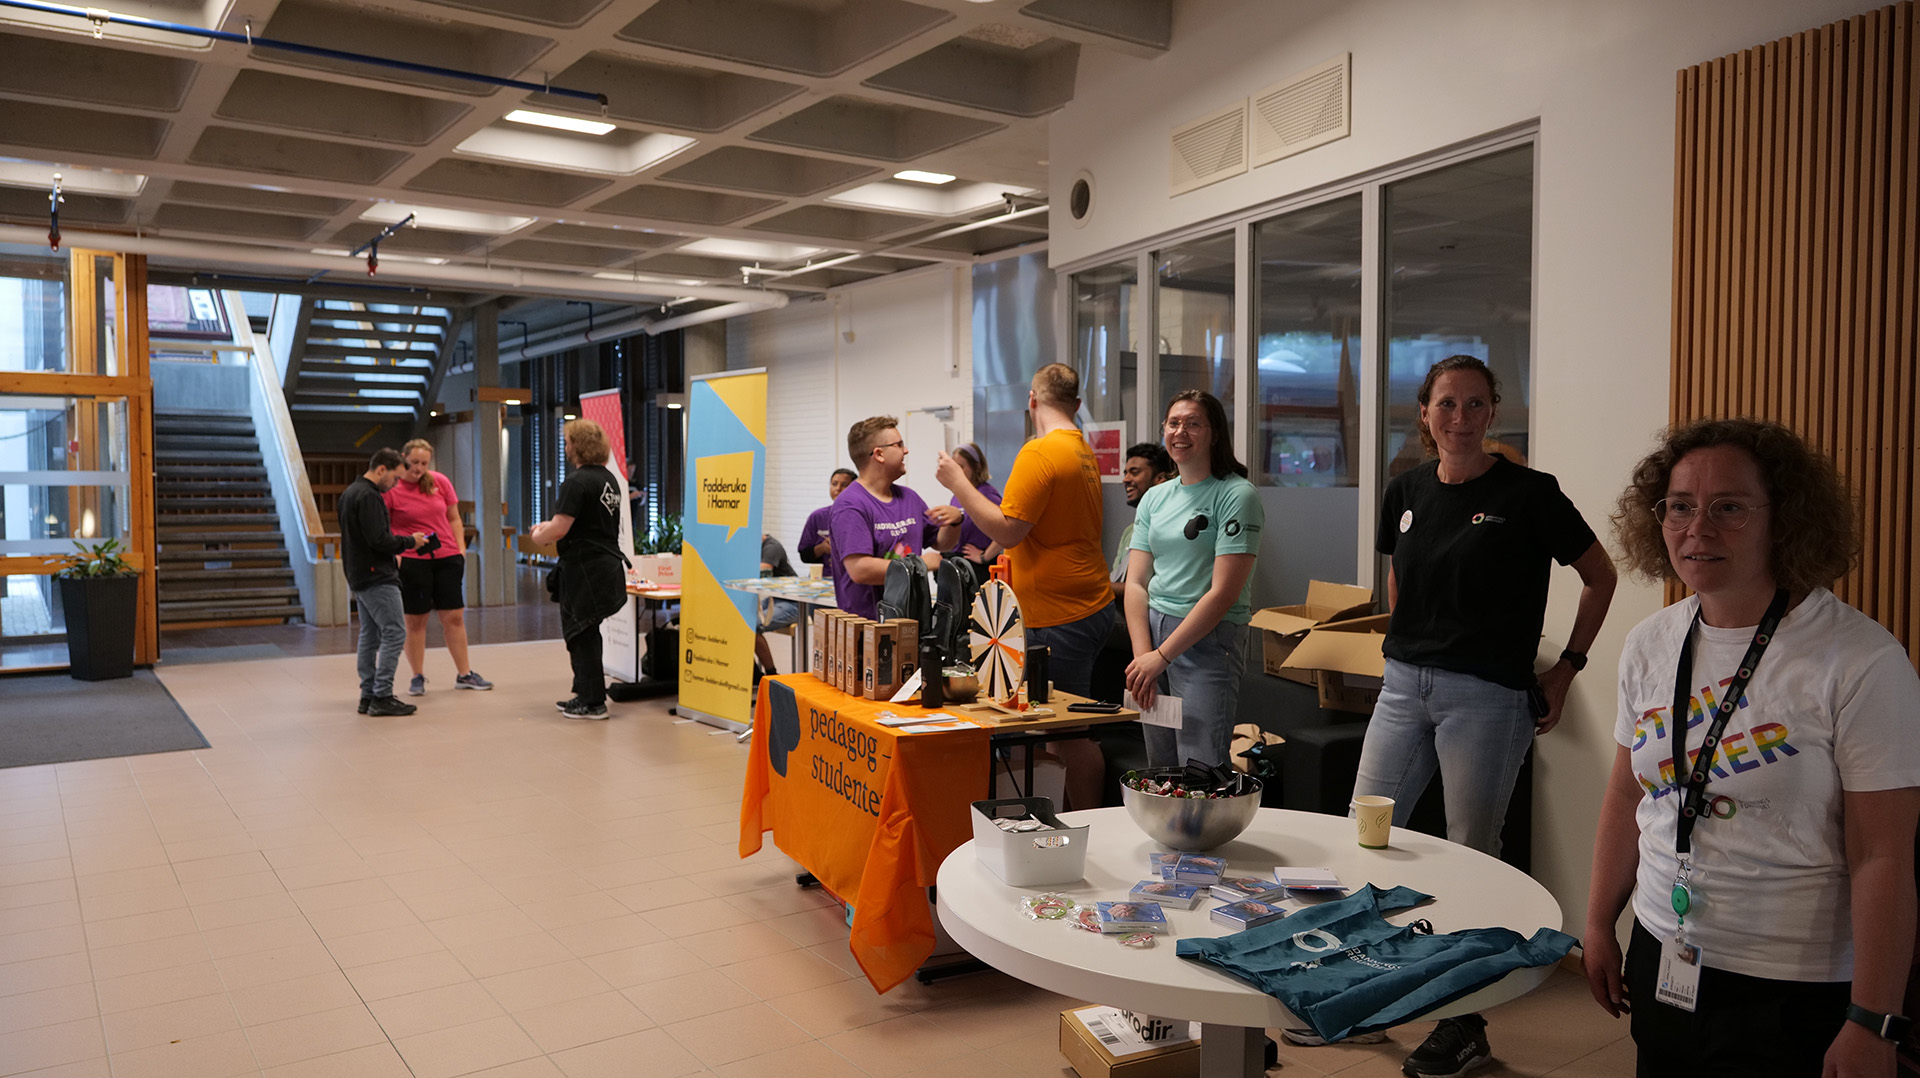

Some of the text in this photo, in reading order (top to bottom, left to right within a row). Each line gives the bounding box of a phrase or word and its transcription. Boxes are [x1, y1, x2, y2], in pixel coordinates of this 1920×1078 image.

[703, 477, 747, 493] Fadderuka
[707, 494, 741, 509] i Hamar
[811, 754, 883, 817] studente
